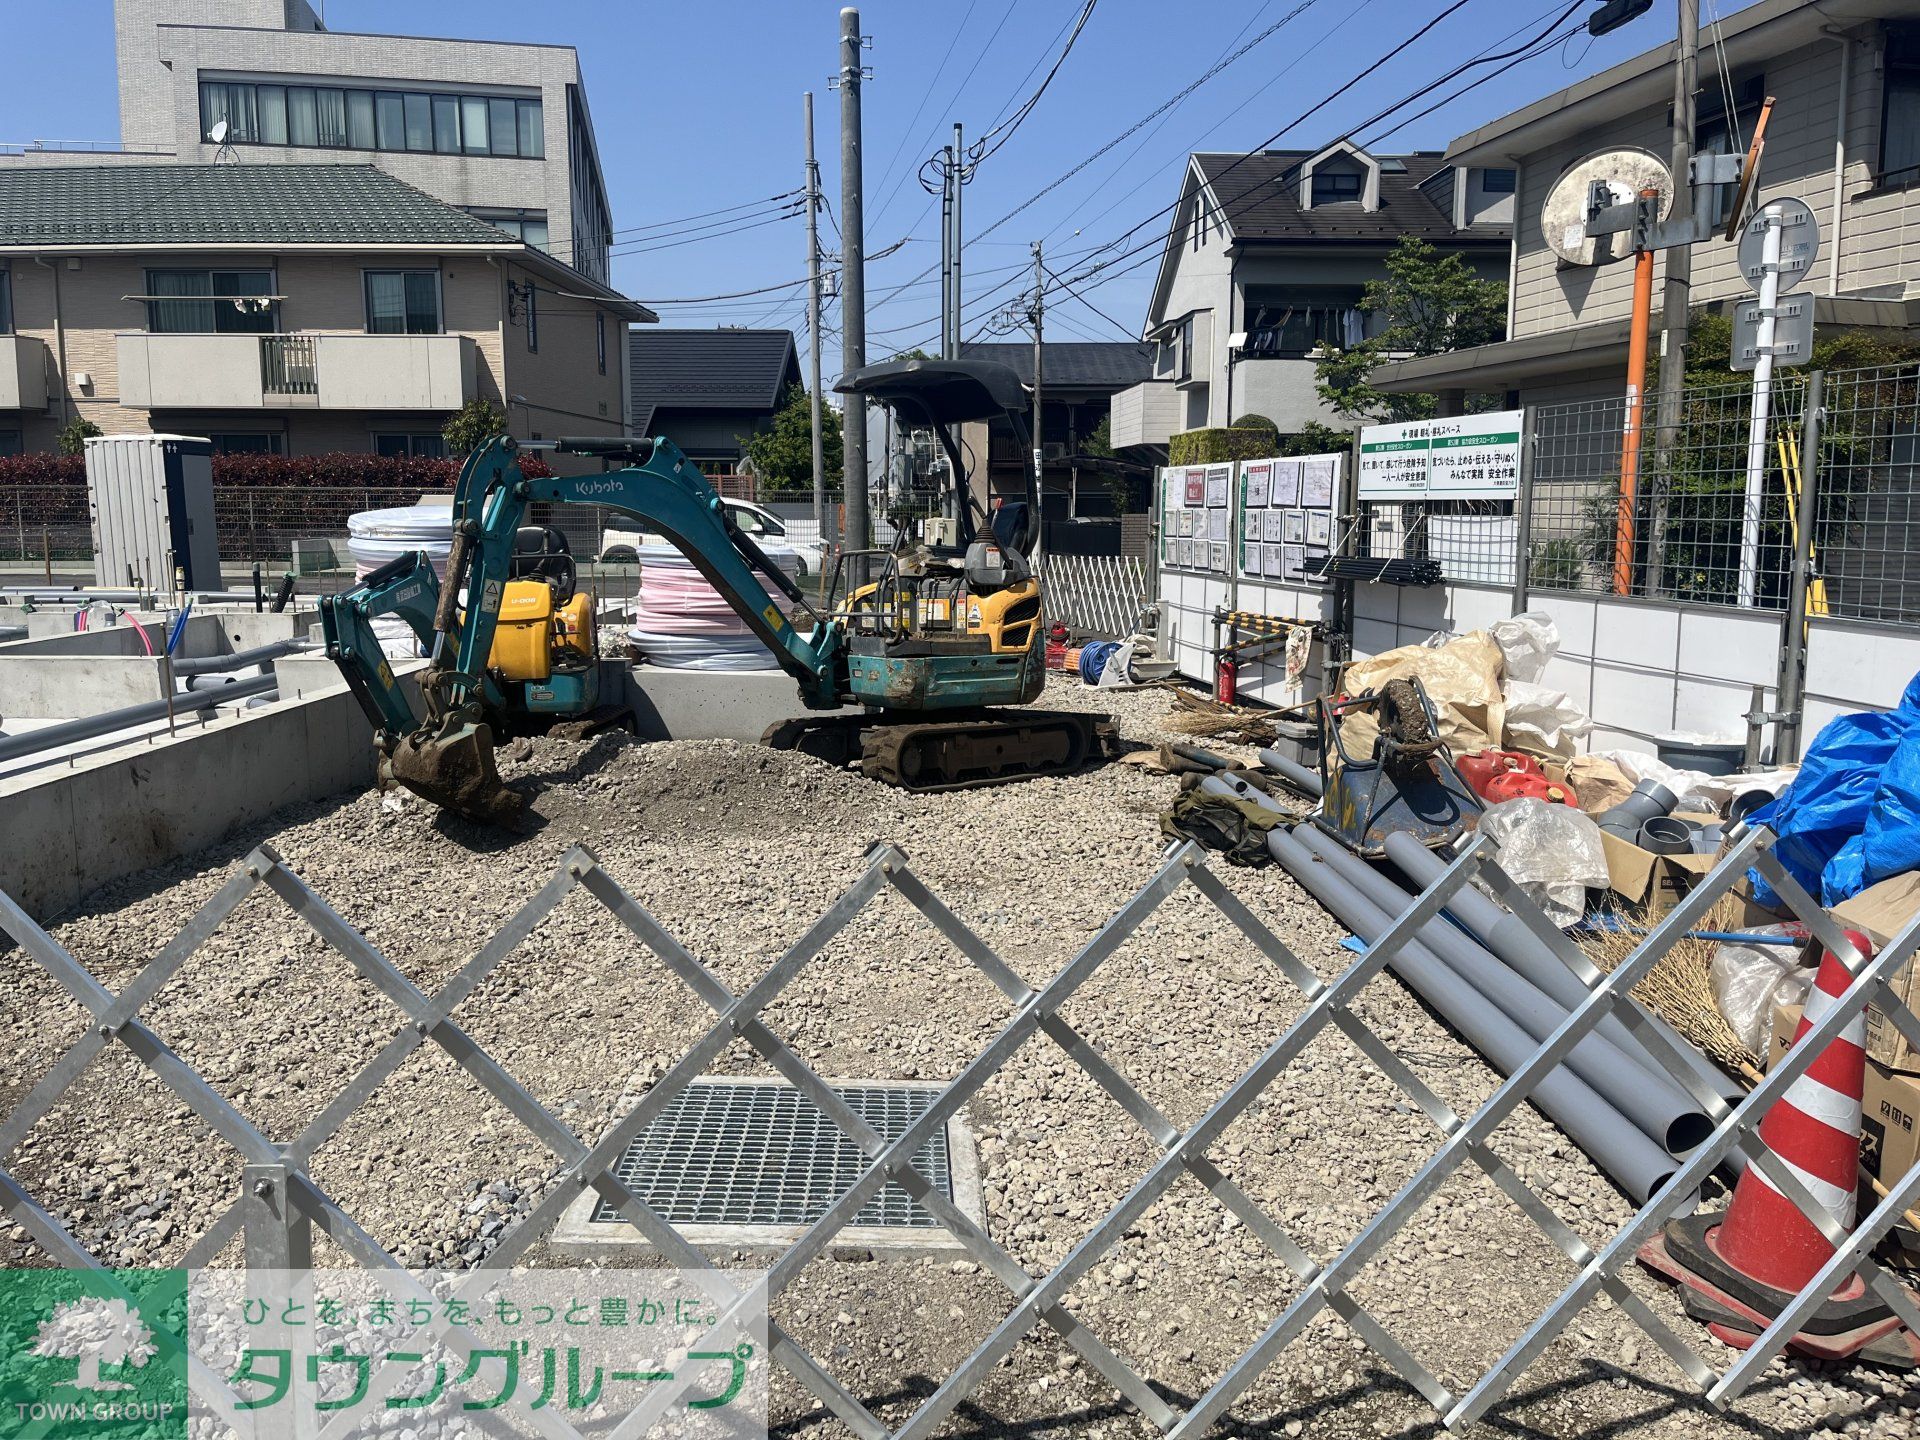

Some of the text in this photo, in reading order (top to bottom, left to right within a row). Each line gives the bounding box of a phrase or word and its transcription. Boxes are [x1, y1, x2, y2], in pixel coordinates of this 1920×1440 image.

[1487, 467, 1516, 480] 安全作業
[575, 479, 624, 496] Kubota
